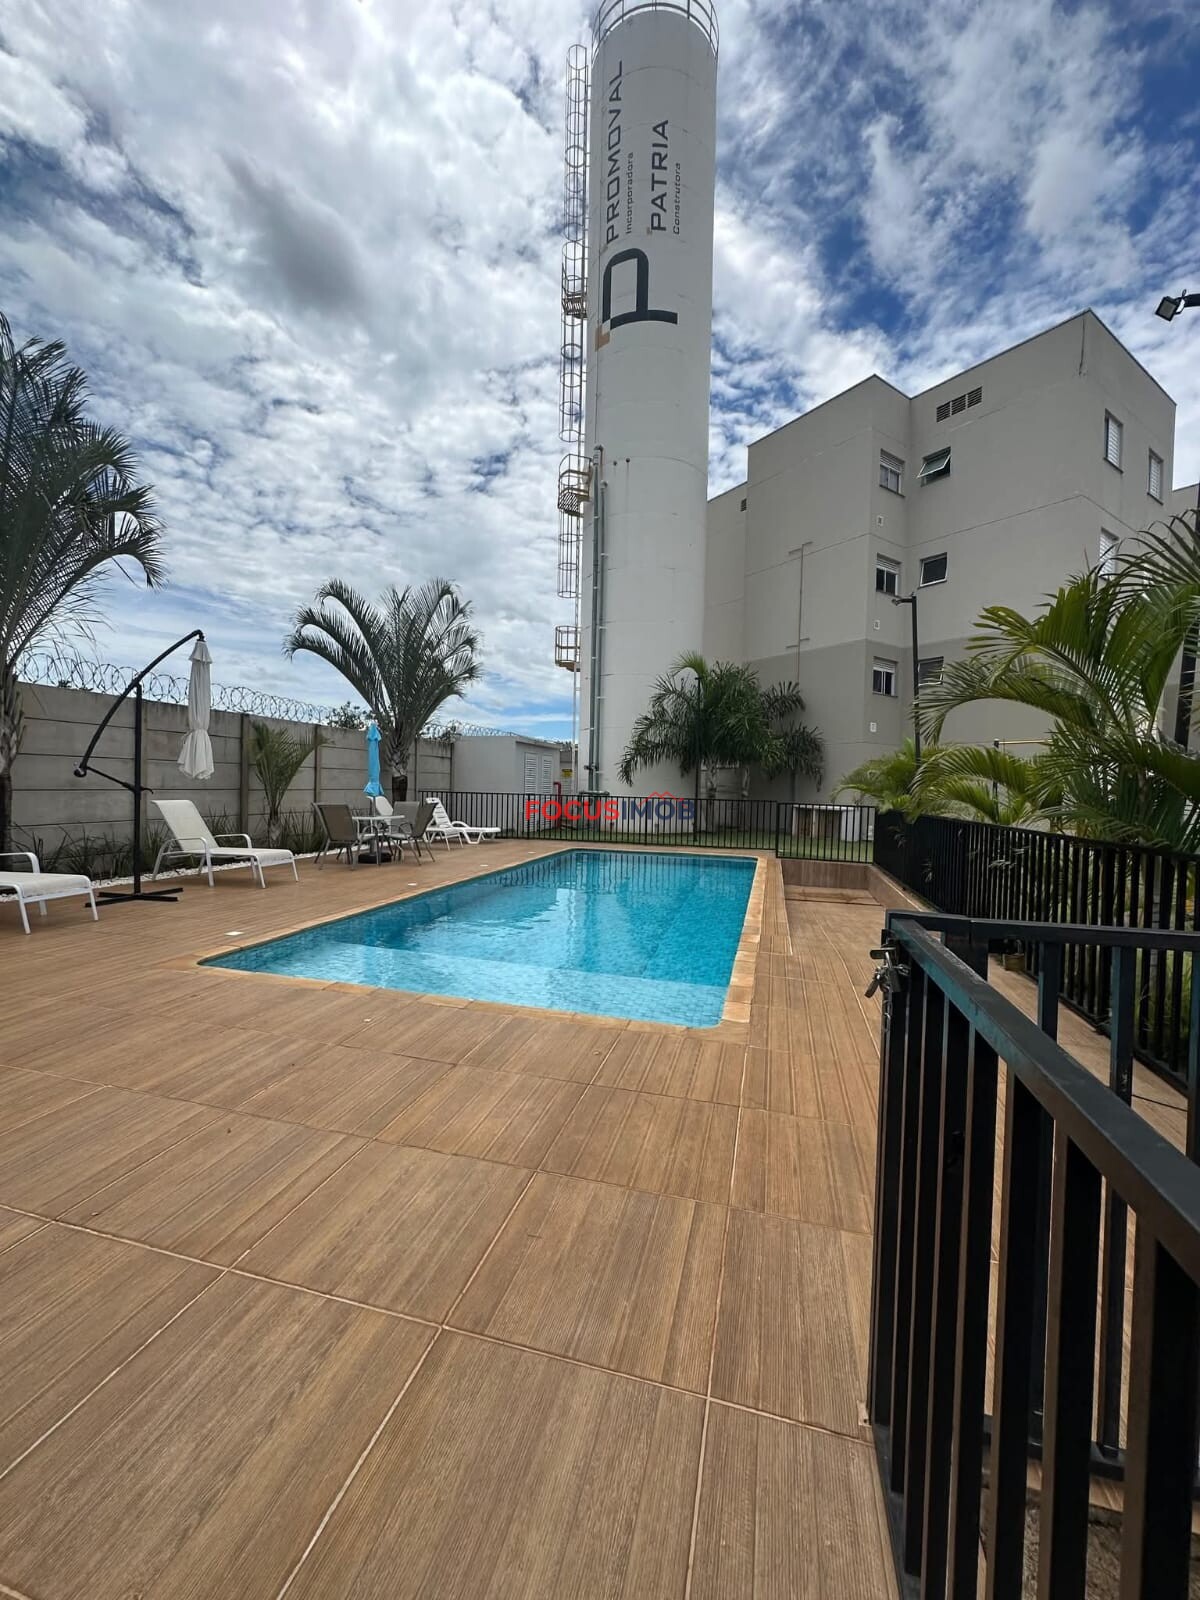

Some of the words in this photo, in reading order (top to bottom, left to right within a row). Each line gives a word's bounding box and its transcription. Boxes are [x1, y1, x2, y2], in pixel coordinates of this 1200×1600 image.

[606, 60, 623, 245] PROMOVAL
[626, 151, 635, 234] Incorporadora
[650, 119, 669, 232] PATRIA
[672, 162, 682, 235] Construtora
